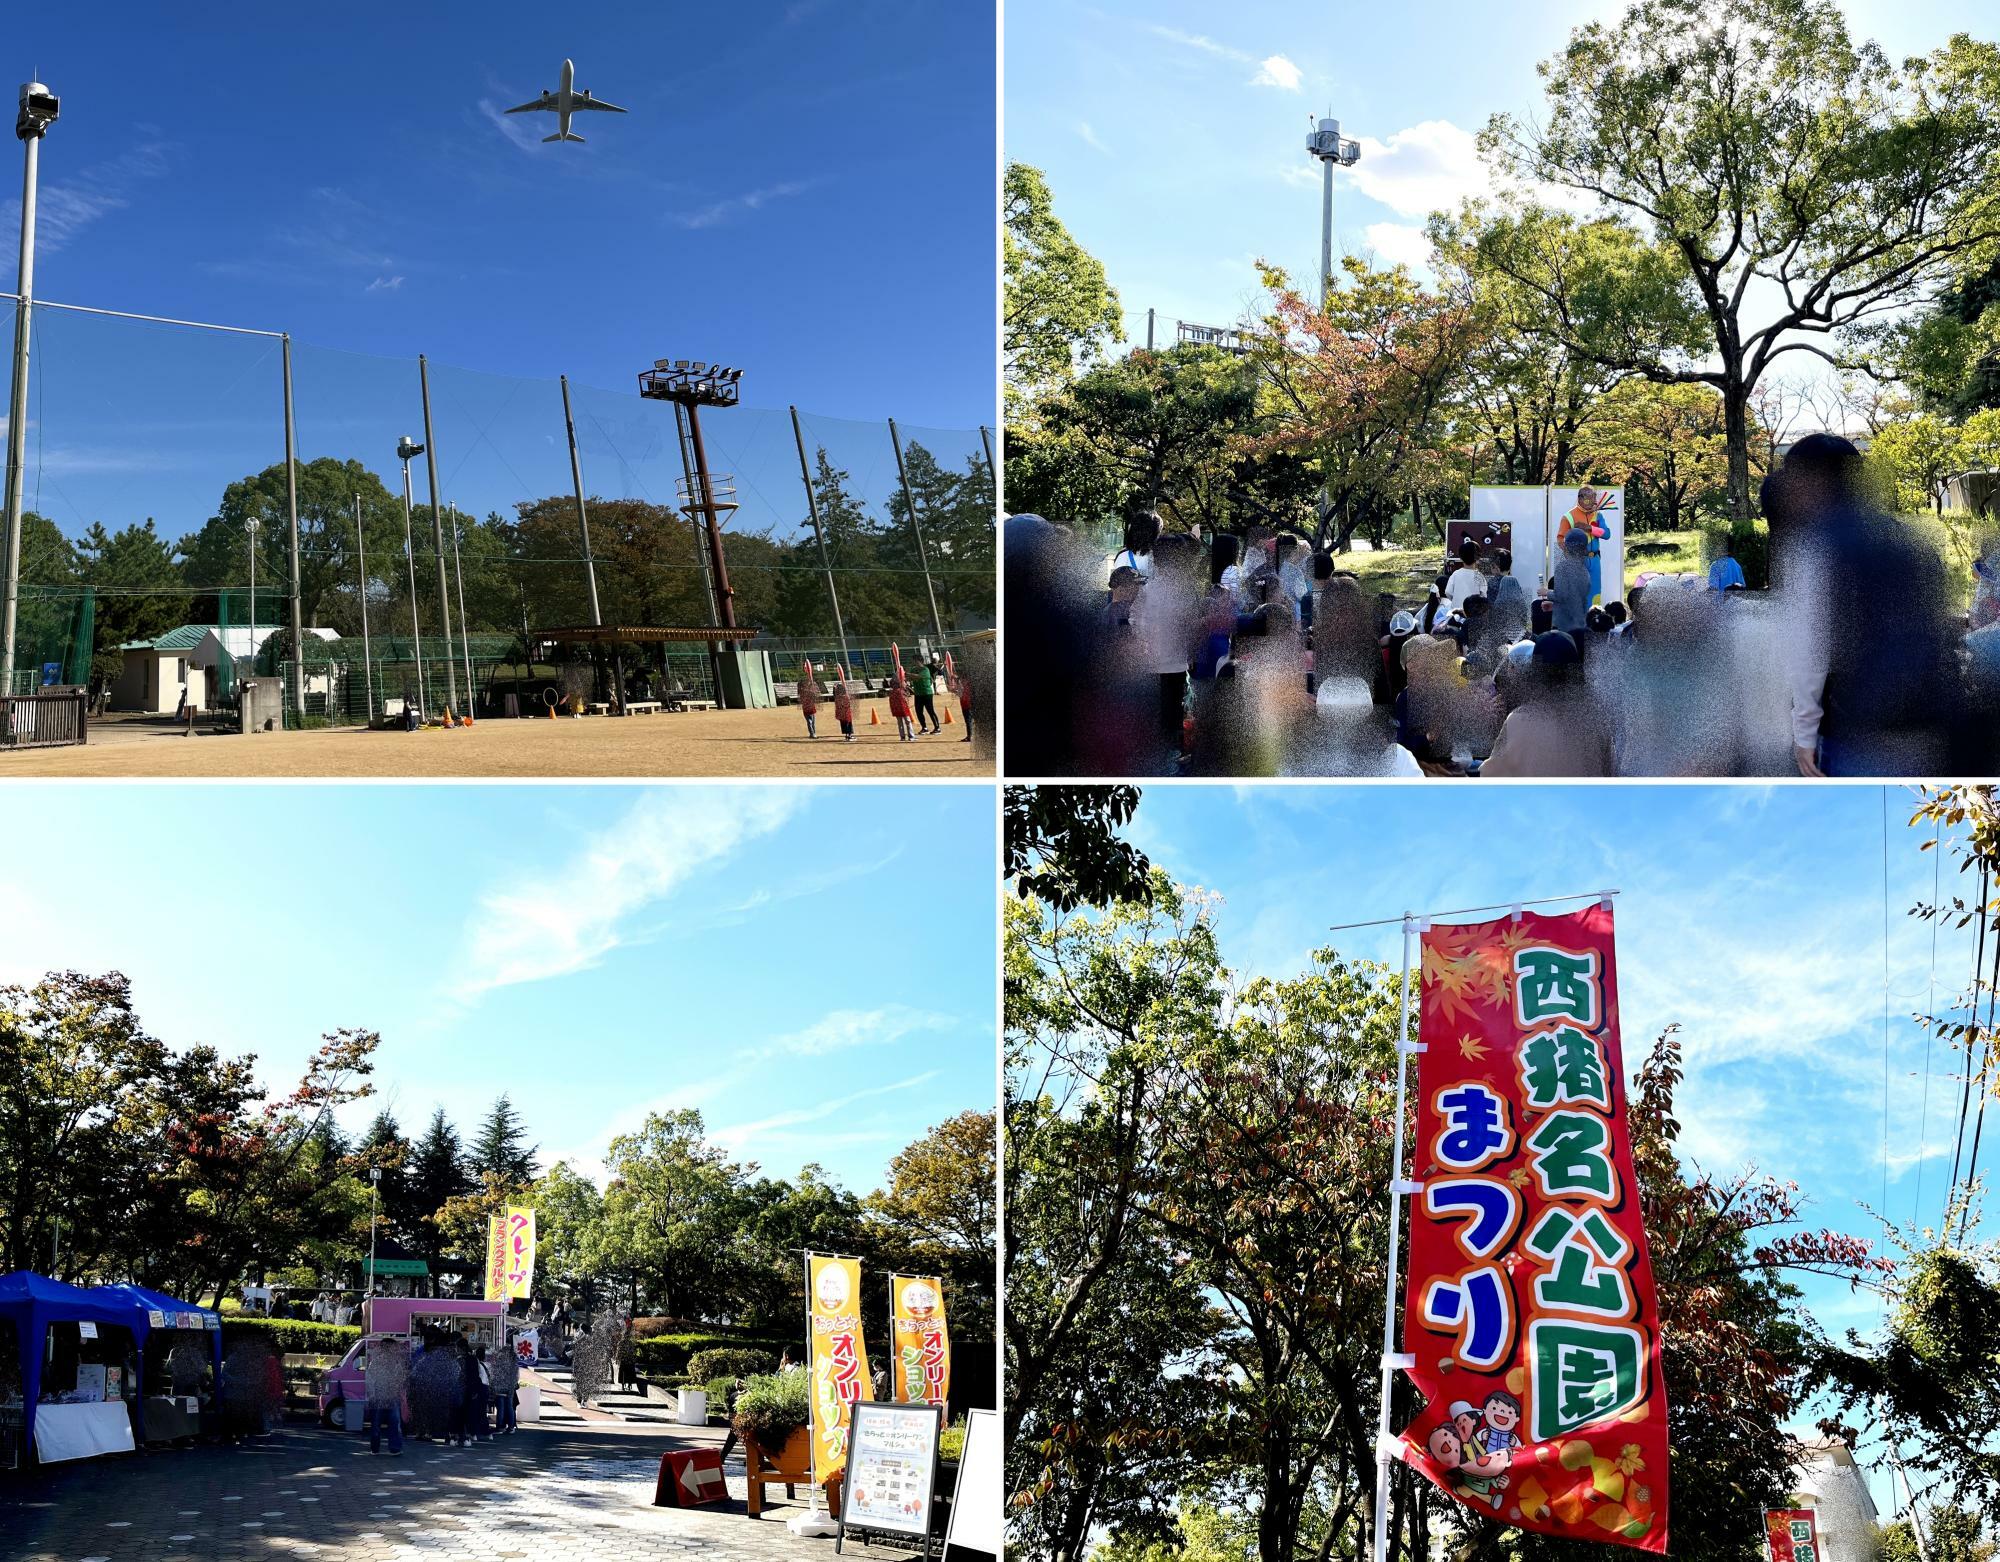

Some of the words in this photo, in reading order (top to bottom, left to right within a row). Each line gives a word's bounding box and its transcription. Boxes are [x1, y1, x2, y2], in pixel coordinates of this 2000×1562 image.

[1425, 1082, 1516, 1367] まつり
[1514, 946, 1641, 1443] 西猪名公園
[508, 1214, 529, 1289] クレープ
[517, 1340, 534, 1357] 氷
[902, 1345, 926, 1406] ショッ
[924, 1331, 945, 1406] オンリー
